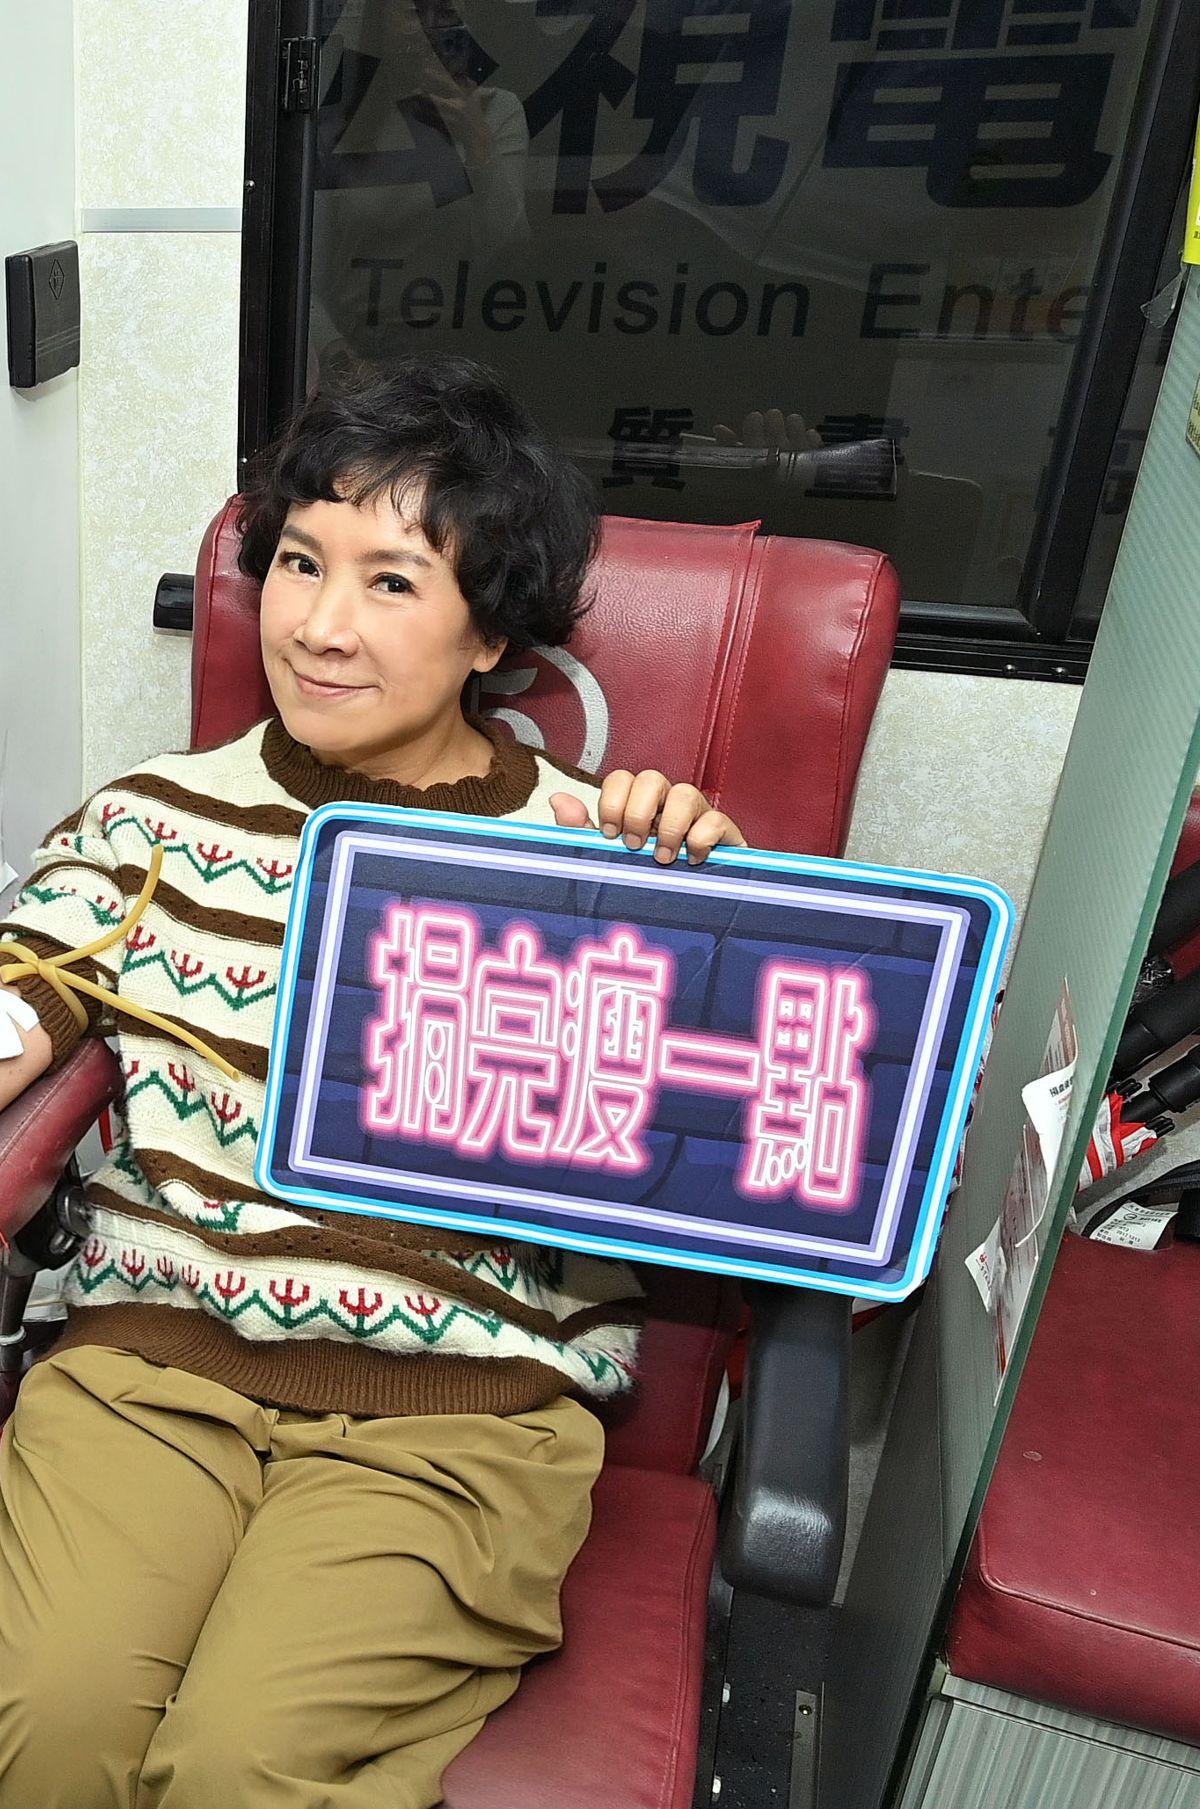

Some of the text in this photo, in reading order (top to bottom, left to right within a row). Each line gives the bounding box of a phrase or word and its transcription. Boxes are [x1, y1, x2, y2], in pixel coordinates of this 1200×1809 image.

[350, 258, 810, 338] Television
[367, 906, 866, 1202] 捐完瘦一點
